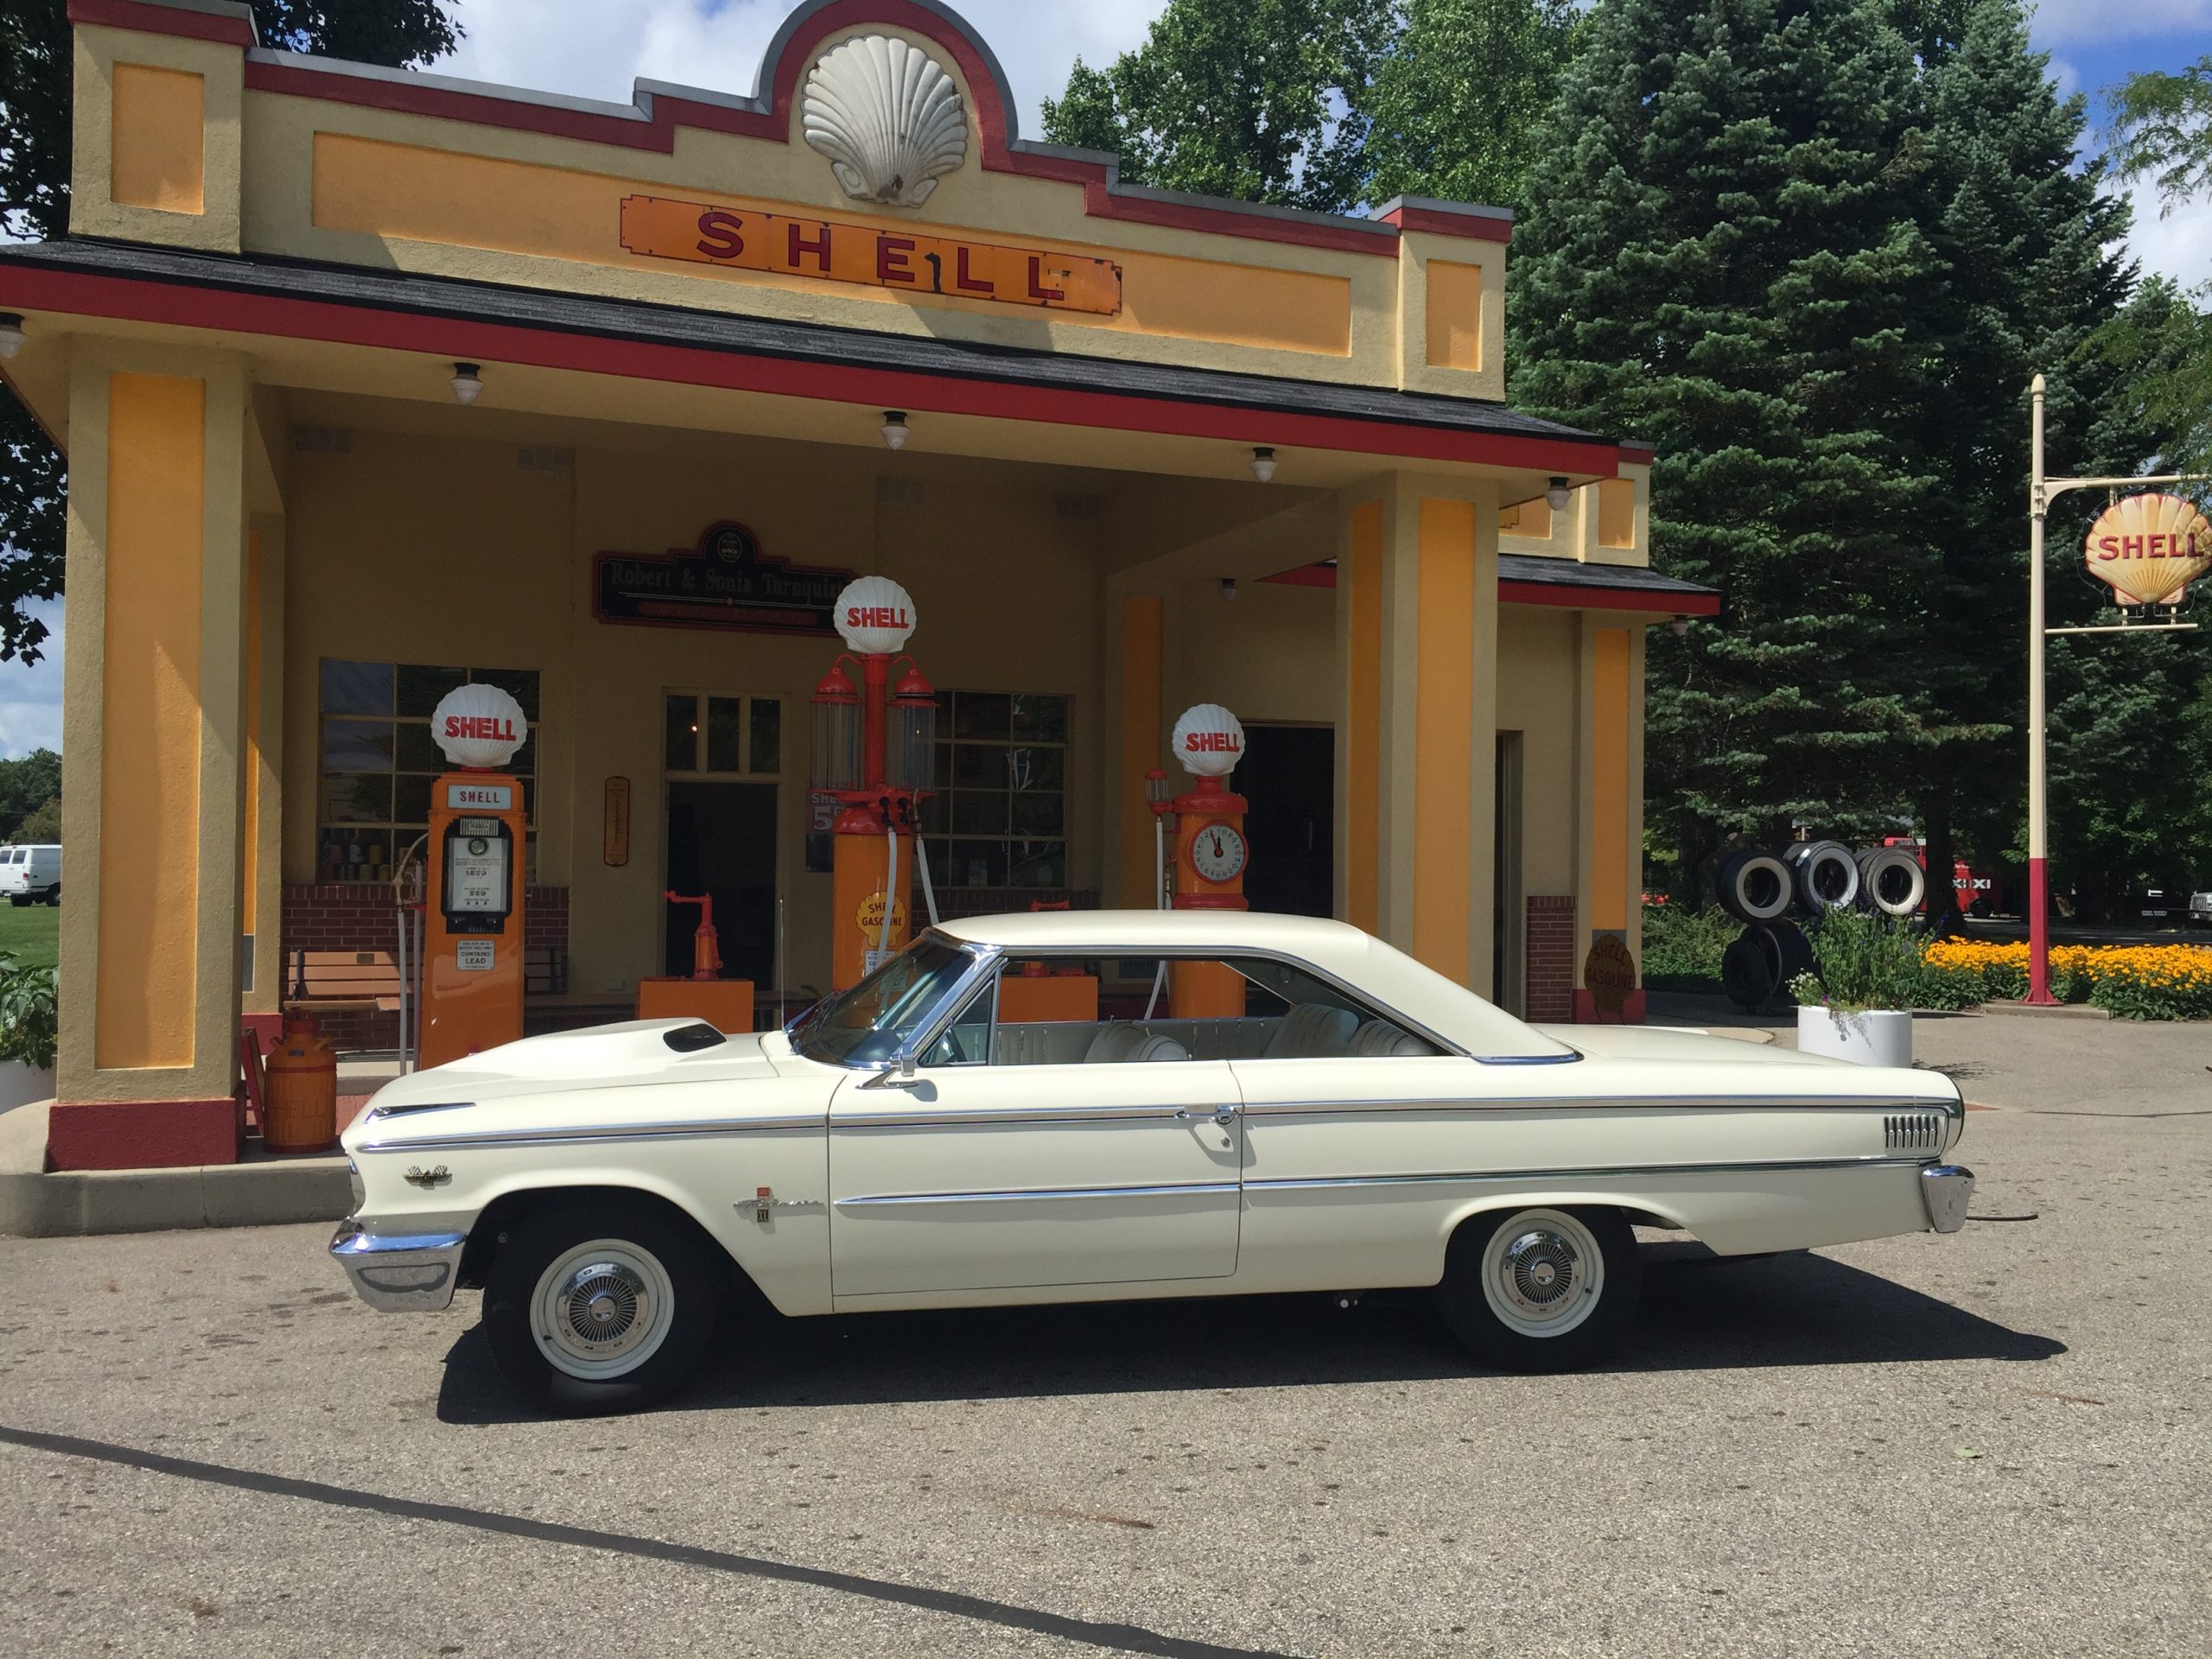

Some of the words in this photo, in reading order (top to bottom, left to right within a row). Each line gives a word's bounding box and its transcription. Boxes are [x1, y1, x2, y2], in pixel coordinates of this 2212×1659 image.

[696, 212, 1065, 301] SHELL
[2097, 532, 2204, 561] SHELL
[610, 563, 671, 588] Robert
[680, 567, 696, 588] &
[705, 568, 753, 594] Sonia
[846, 607, 909, 629] SHELL
[444, 716, 517, 741] SHELL
[1185, 733, 1240, 752] SHELL
[460, 791, 499, 804] SHELL
[862, 917, 901, 926] GASOINE
[1593, 944, 1624, 965] SHELL
[1586, 968, 1635, 990] GASOLINE
[758, 1210, 768, 1221] XL
